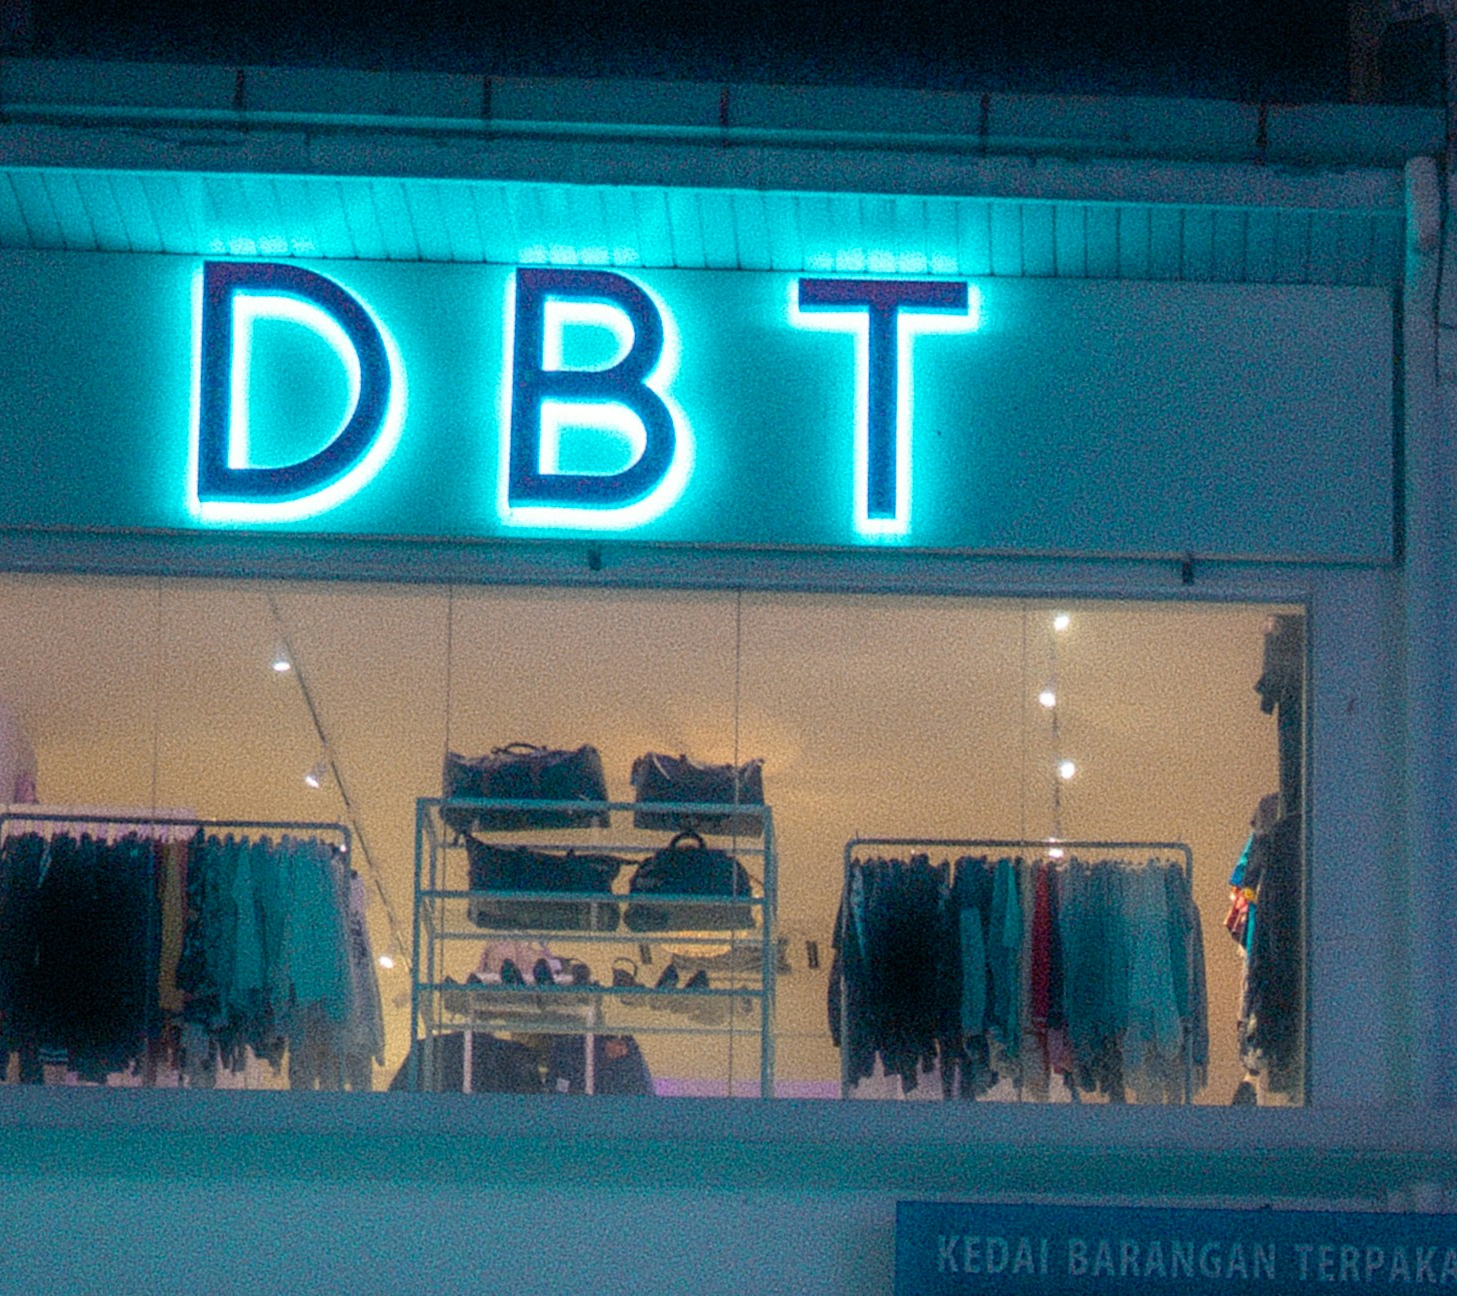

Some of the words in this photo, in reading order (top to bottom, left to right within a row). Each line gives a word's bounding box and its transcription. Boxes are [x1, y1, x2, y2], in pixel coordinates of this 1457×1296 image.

[194, 258, 974, 528] DBT
[938, 1234, 1049, 1275] KEDAI
[1067, 1237, 1277, 1280] BARANGAN
